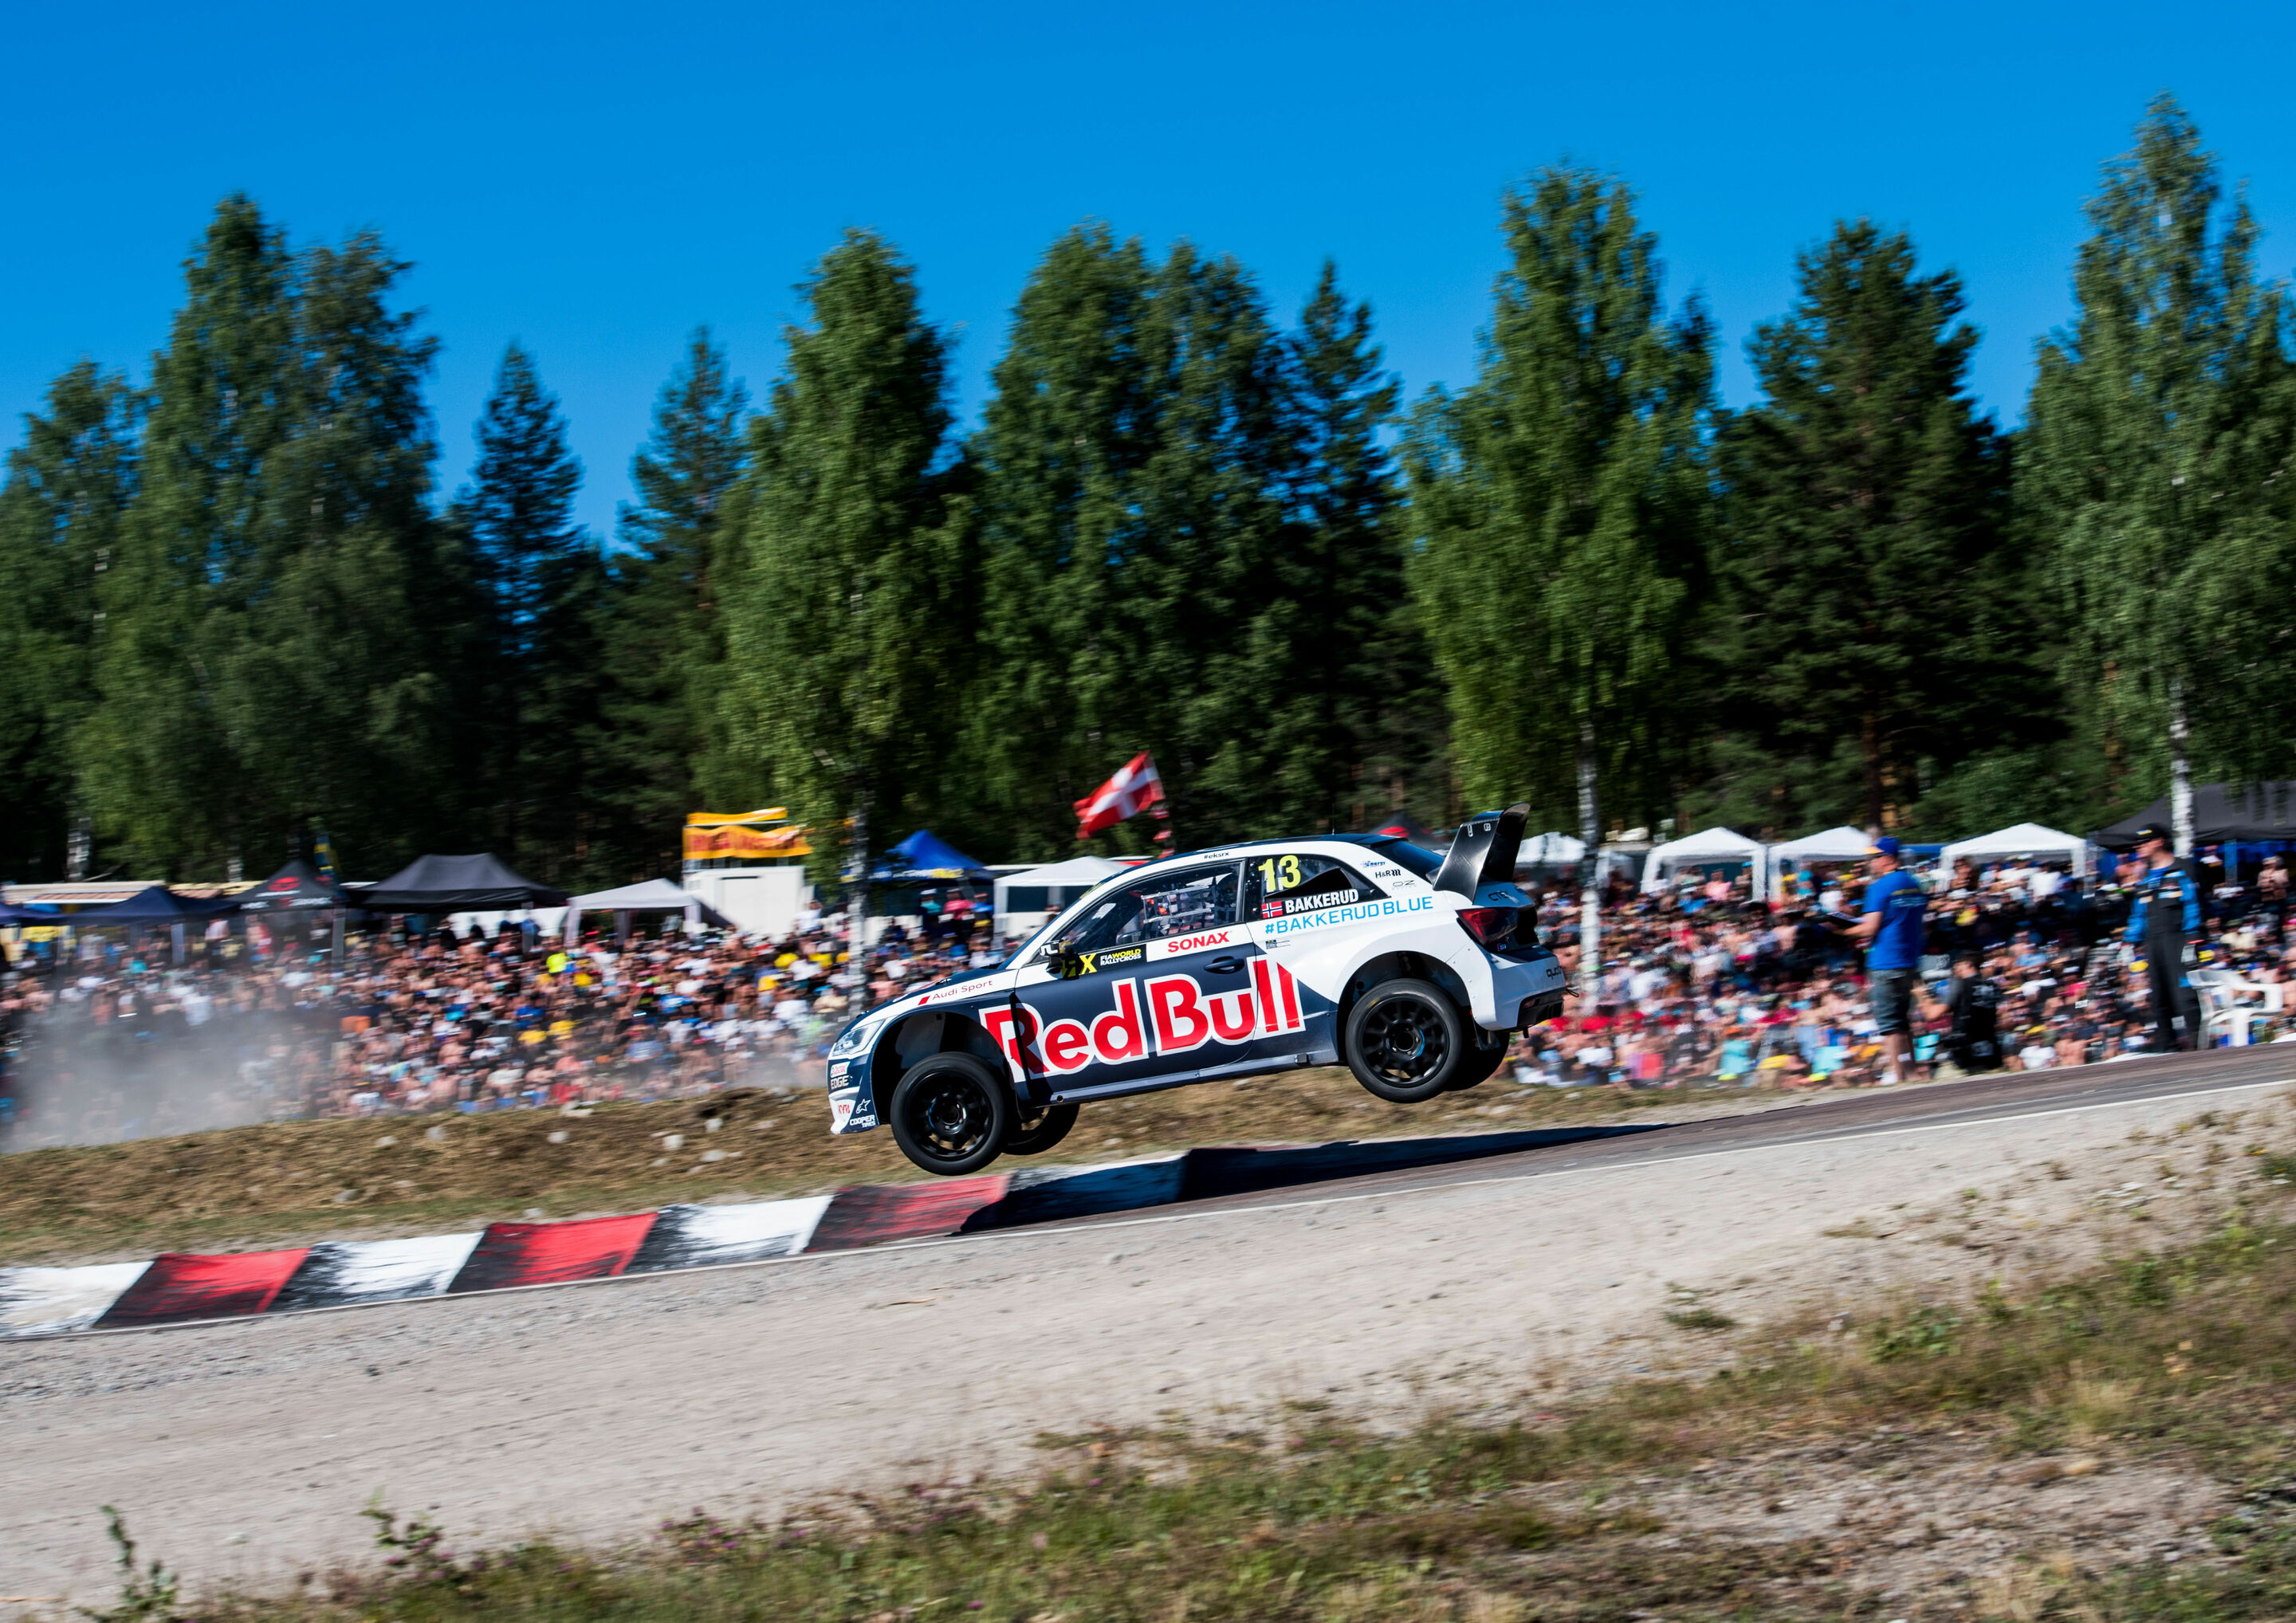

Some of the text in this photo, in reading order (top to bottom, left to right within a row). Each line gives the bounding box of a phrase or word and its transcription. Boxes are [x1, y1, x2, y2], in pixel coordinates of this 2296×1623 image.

[1258, 855, 1301, 891] 13
[1285, 889, 1359, 914] BAKKERUD
[1167, 931, 1230, 953] SONAX
[1100, 953, 1142, 966] RALLYCROSS
[932, 980, 993, 1000] Audi Sport
[984, 959, 1301, 1075] Red Bull
[831, 1075, 850, 1090] EDGE
[849, 1114, 875, 1126] COOPER
